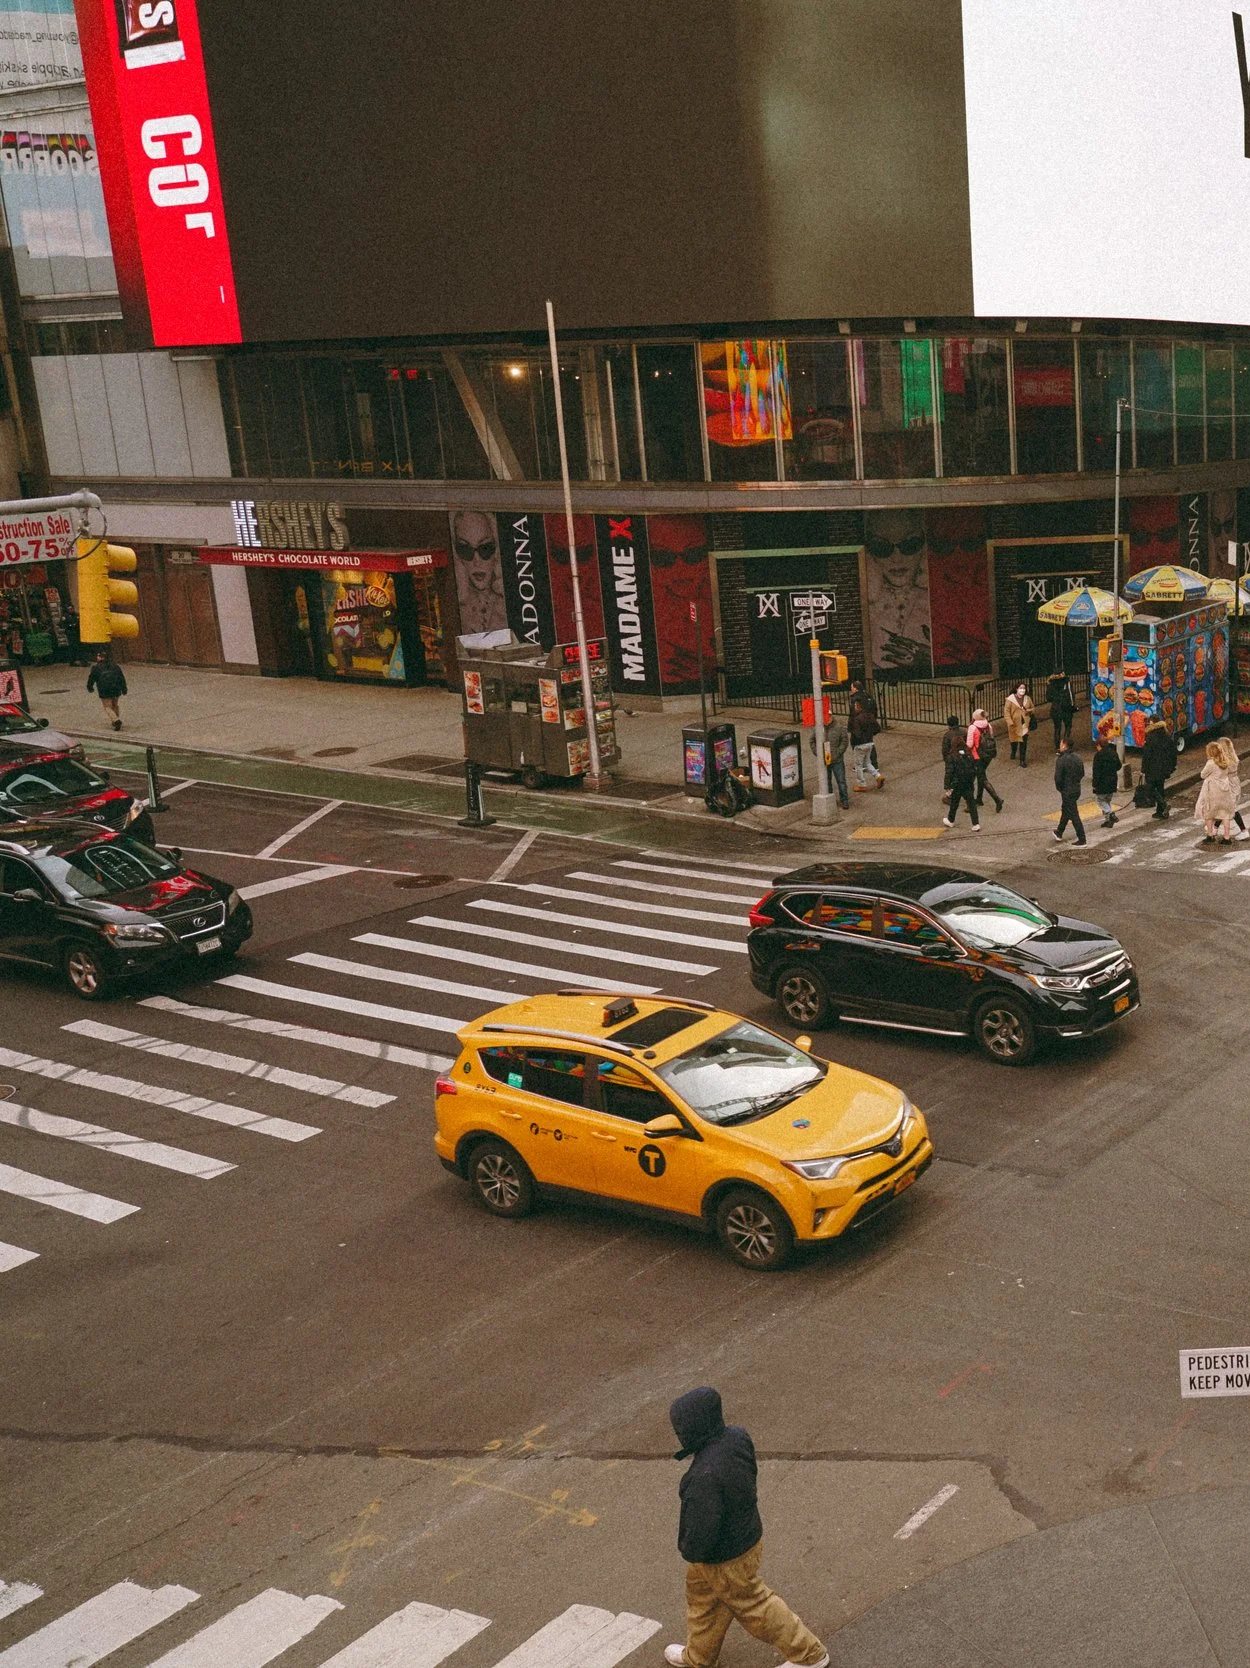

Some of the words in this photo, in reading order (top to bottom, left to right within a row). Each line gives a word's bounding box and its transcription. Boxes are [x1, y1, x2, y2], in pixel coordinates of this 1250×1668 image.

[47, 515, 71, 535] Sale
[230, 500, 346, 551] HERSHEY'S
[608, 516, 633, 541] X
[1188, 496, 1200, 573] ONNA
[232, 551, 275, 563] HERSHEY'S
[278, 553, 328, 565] CHOCOLATE
[330, 555, 361, 567] WORLD
[512, 515, 540, 645] ADONNA
[797, 598, 810, 606] ONE
[814, 598, 828, 606] WAY
[1144, 591, 1183, 600] SABRETT
[612, 546, 646, 682] MADAME
[1039, 612, 1065, 624] SABRETT
[645, 1151, 660, 1173] T
[1189, 1375, 1221, 1390] KEEP
